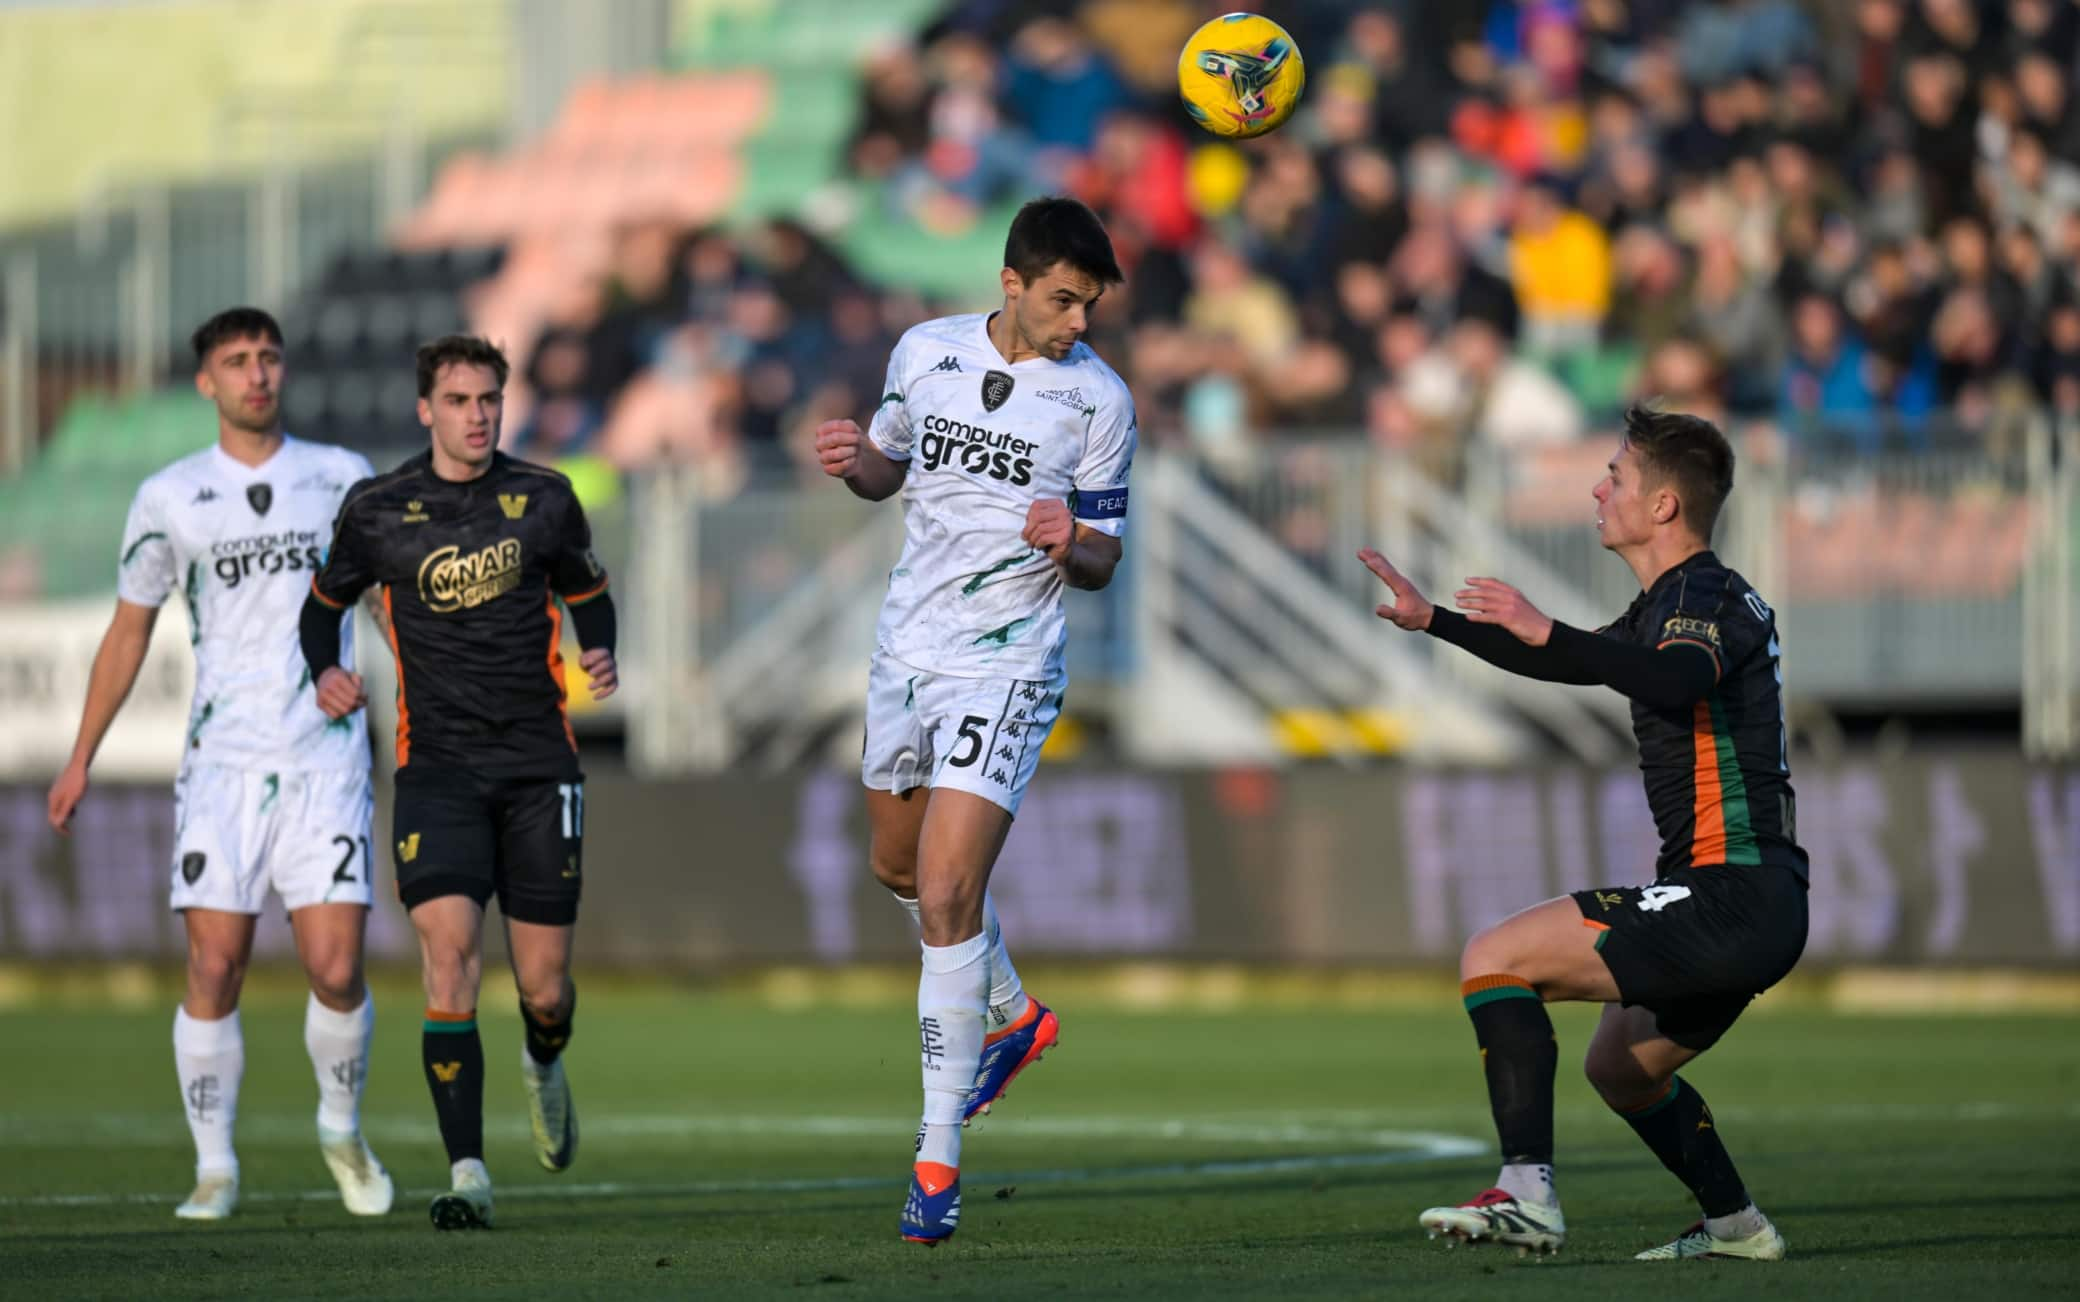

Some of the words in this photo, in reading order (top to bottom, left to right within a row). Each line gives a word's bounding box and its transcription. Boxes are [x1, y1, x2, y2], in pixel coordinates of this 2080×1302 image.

[921, 432, 1034, 487] gross
[924, 415, 1040, 457] computer
[1096, 496, 1128, 512] PEAC
[211, 529, 318, 558] computer
[214, 545, 320, 589] gross
[418, 538, 520, 613] CYNAR
[948, 714, 989, 768] 5
[559, 783, 584, 839] 11
[331, 834, 370, 884] 21
